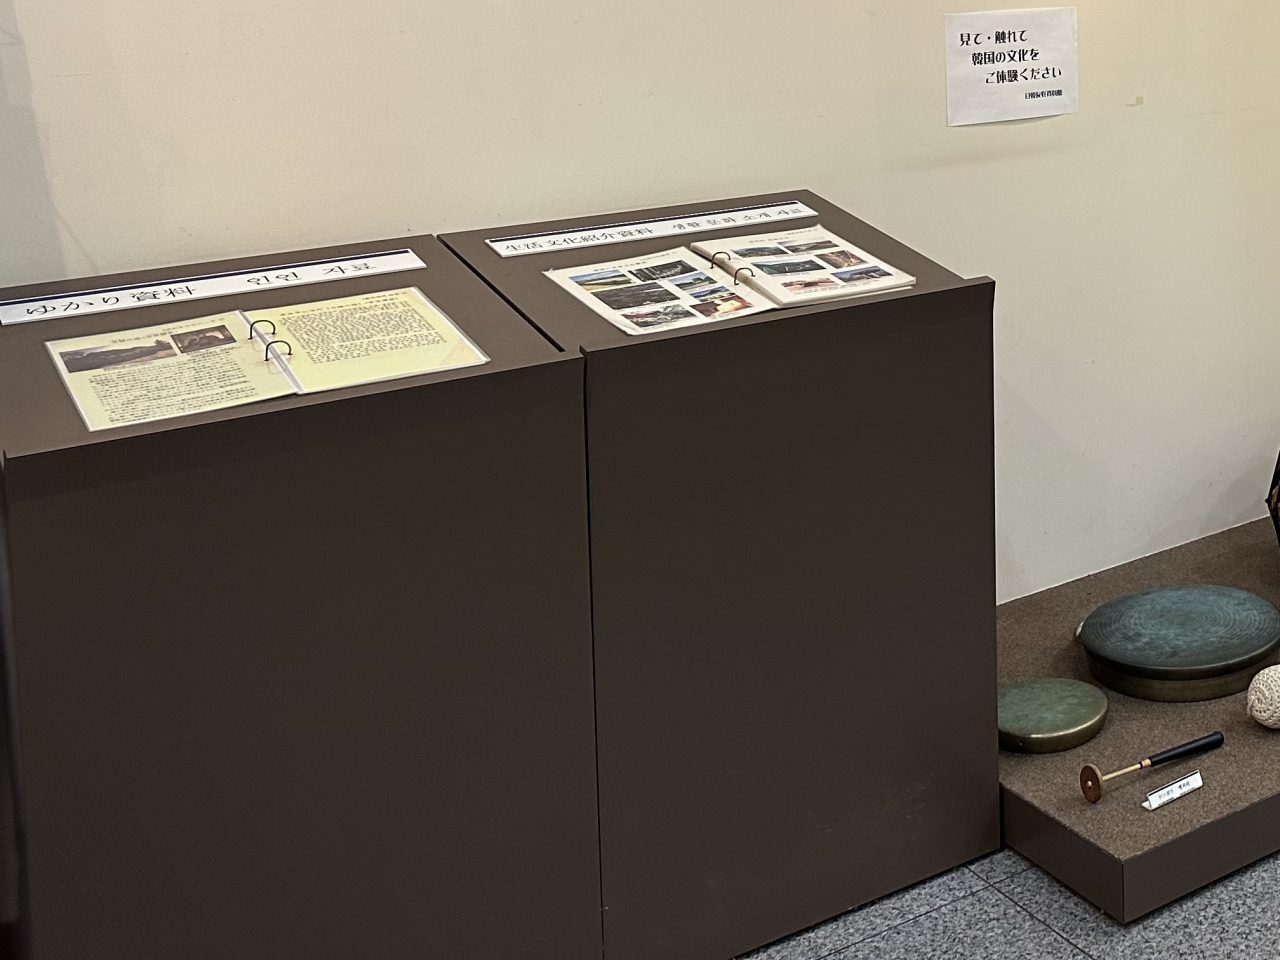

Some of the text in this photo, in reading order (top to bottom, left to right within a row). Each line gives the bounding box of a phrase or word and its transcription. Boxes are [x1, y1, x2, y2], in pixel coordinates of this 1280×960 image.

[972, 48, 1040, 66] 韓国の文化を
[985, 66, 1062, 84] ご体験ください
[505, 226, 653, 251] 生活文化紹介資料
[27, 262, 376, 315] ゆかり資料 인연 자료
